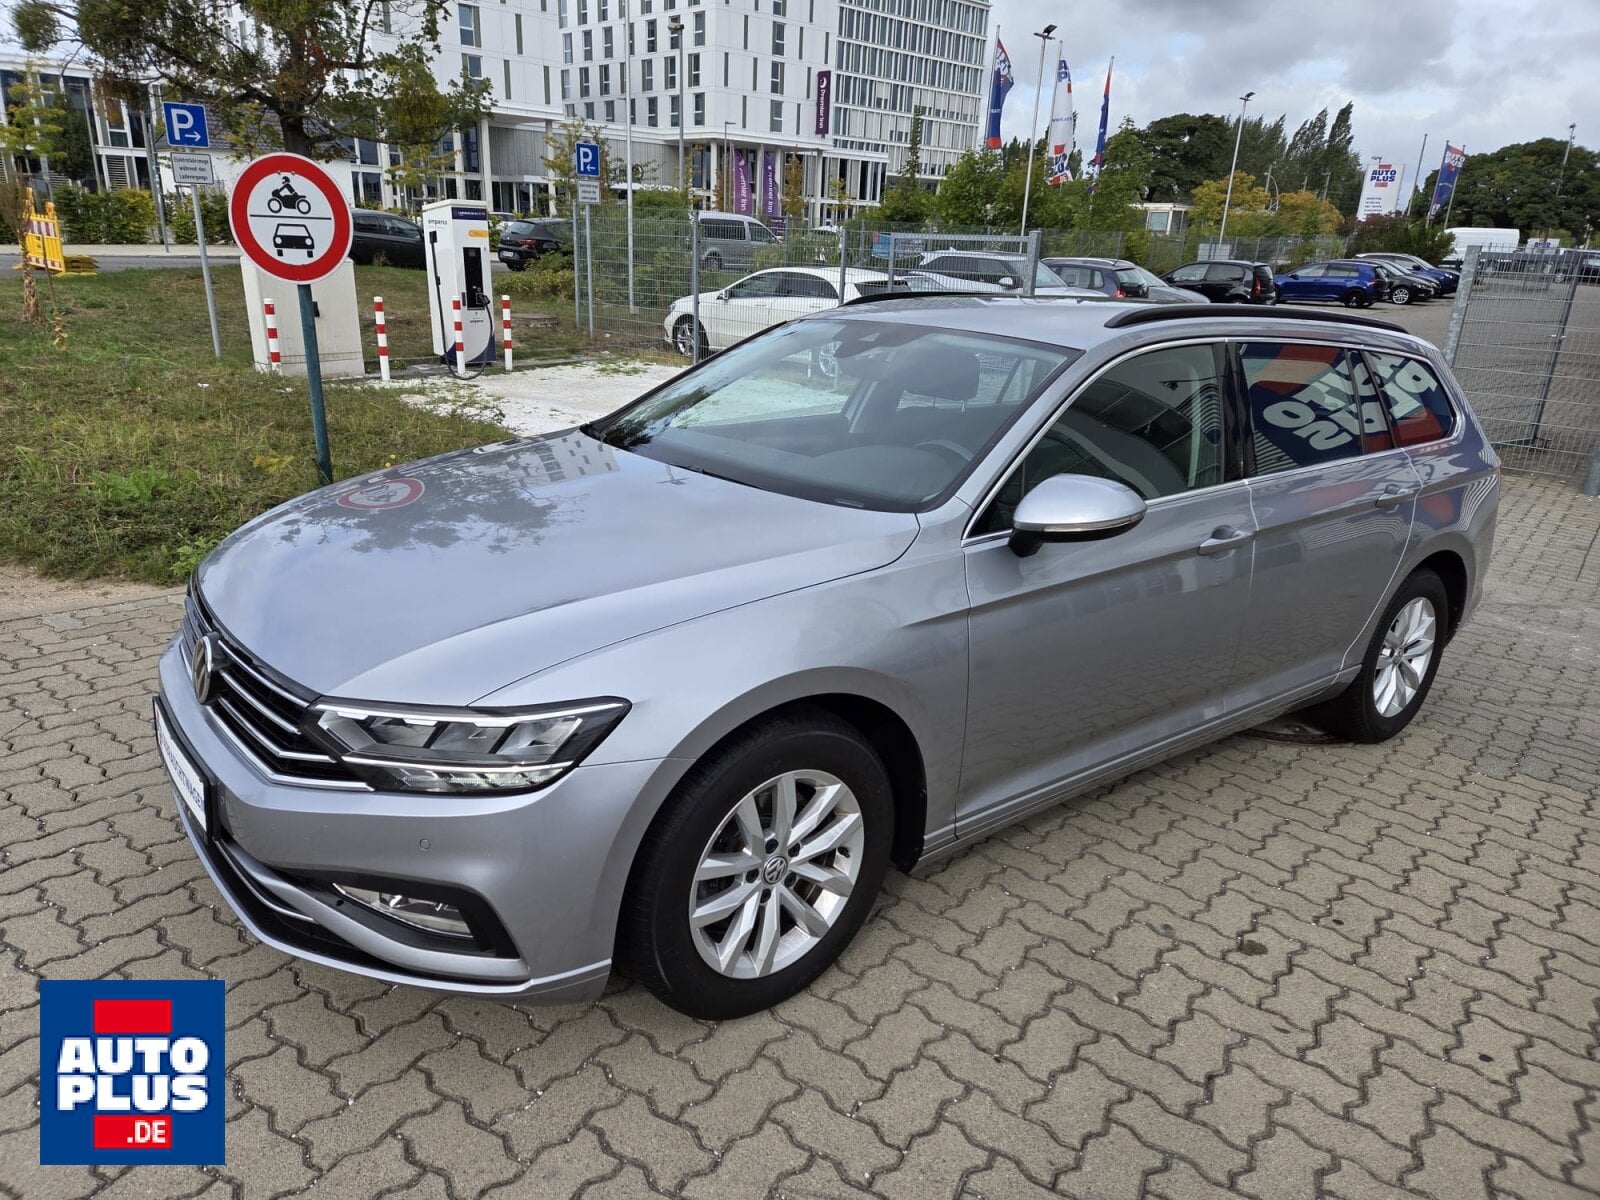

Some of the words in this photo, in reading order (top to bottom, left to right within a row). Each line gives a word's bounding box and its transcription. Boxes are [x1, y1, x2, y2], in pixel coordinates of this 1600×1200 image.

[171, 109, 193, 140] P
[580, 147, 592, 171] P
[740, 198, 748, 211] Inn
